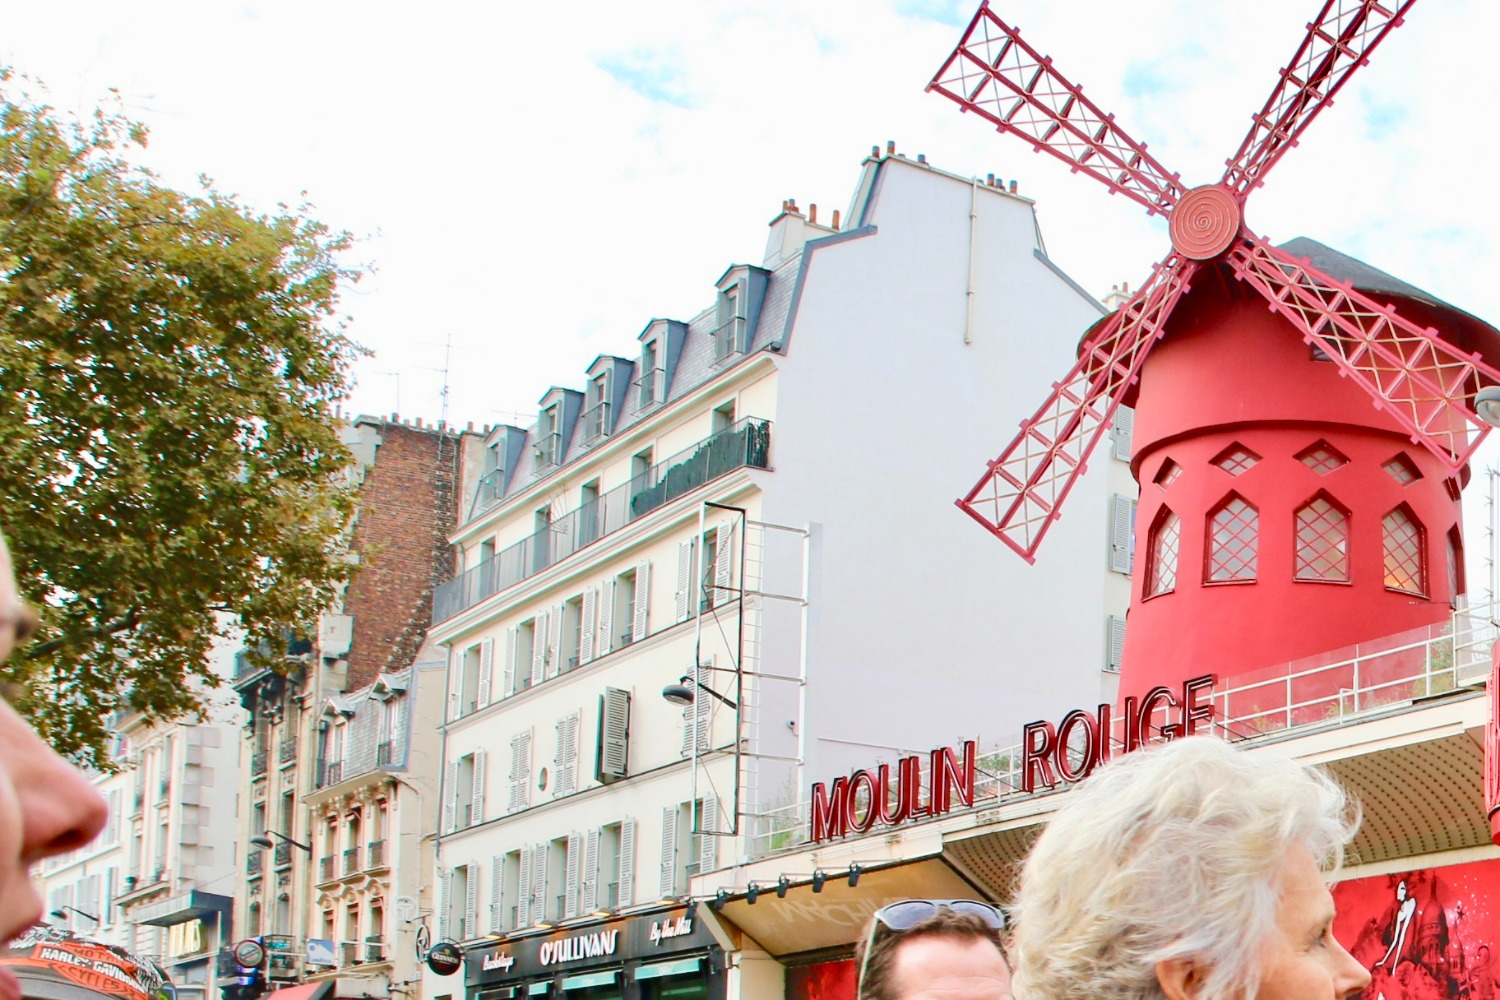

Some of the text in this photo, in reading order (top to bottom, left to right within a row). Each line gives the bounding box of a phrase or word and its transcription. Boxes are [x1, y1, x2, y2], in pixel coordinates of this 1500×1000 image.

[810, 673, 1219, 844] MOULIN ROUGE
[540, 929, 618, 966] O'SULLIVANS
